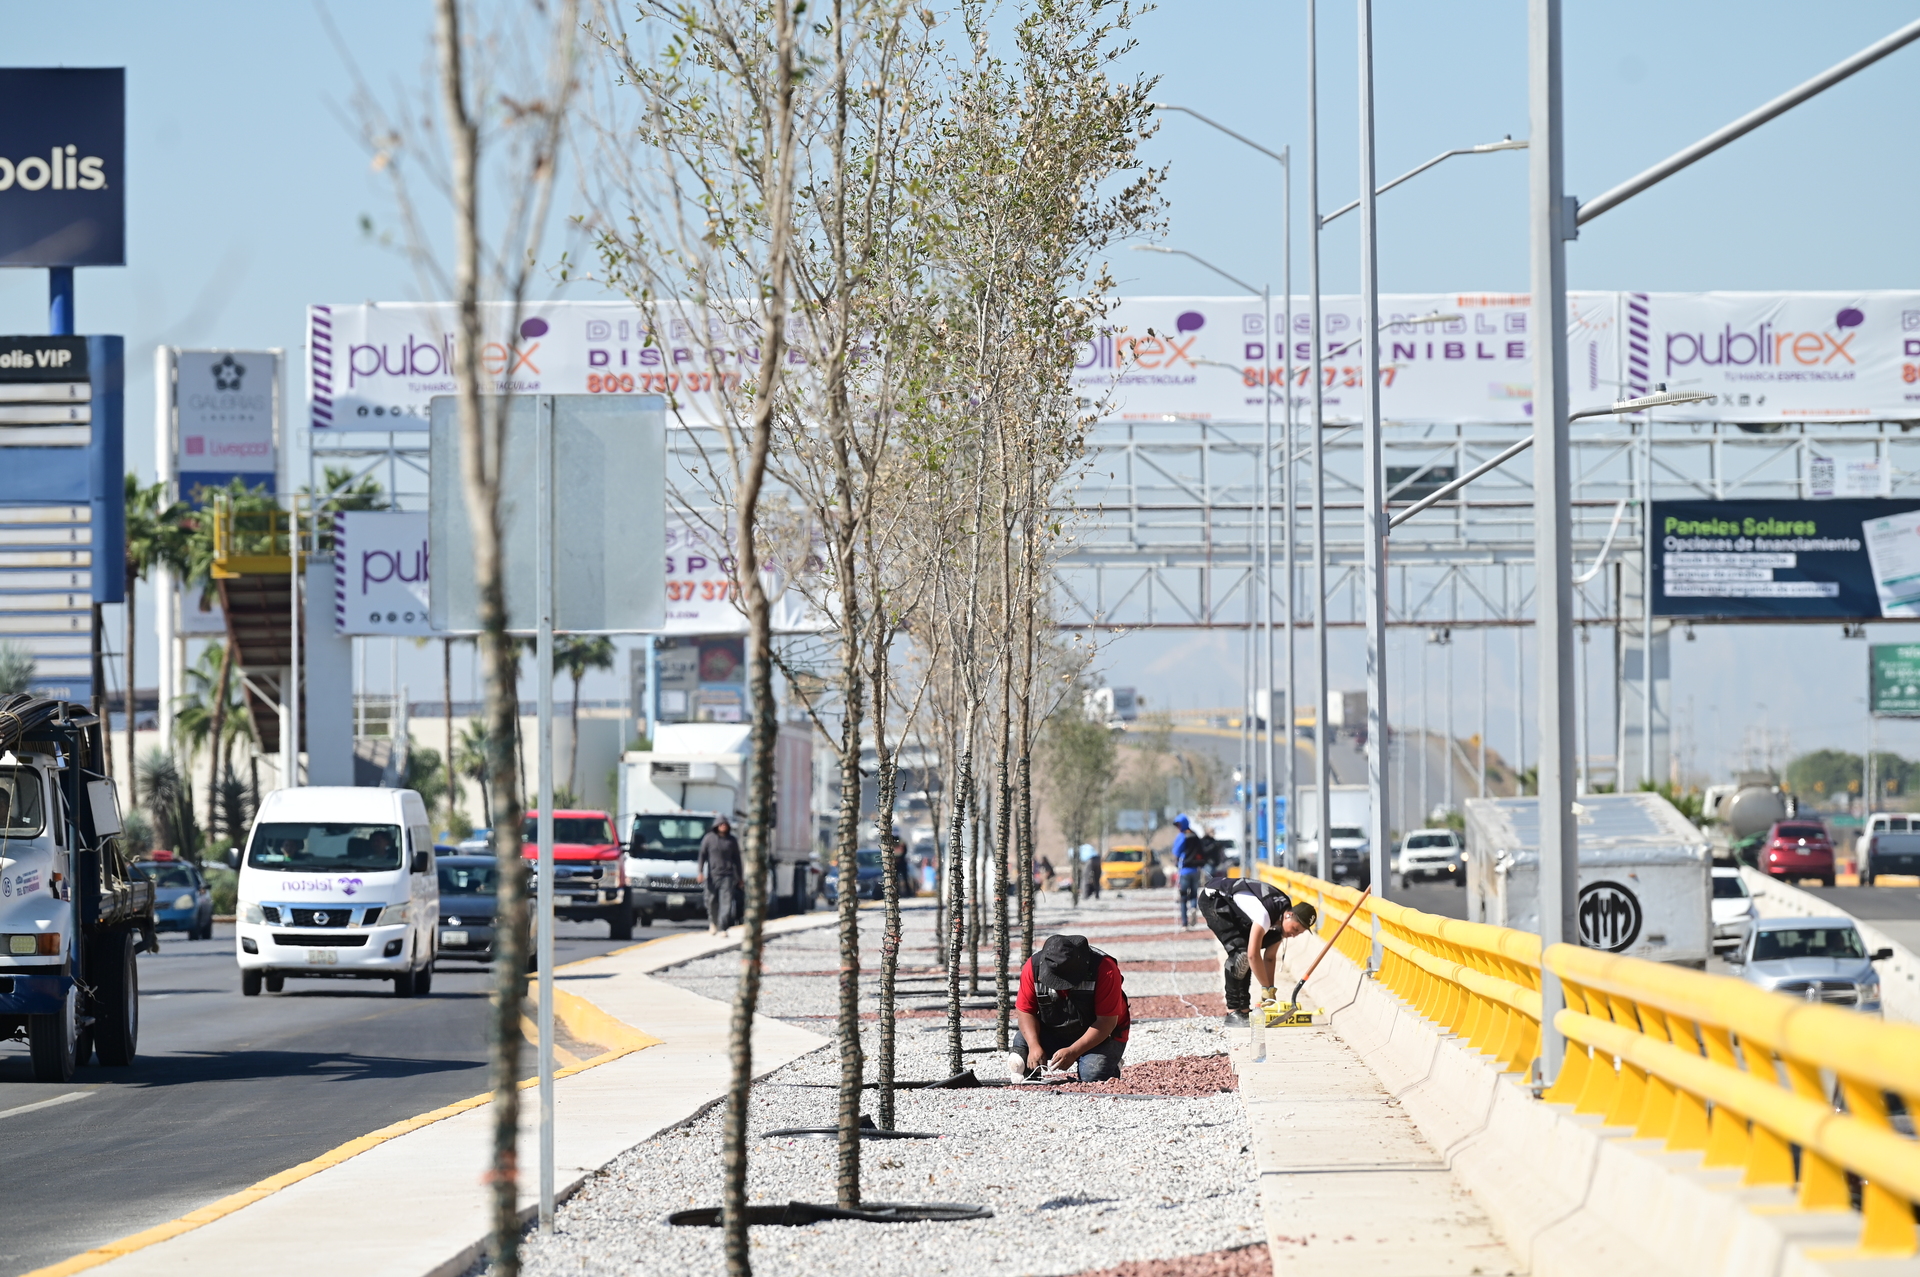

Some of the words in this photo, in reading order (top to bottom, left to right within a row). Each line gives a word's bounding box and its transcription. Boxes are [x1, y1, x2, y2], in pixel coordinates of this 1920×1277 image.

[1242, 313, 1526, 335] DISPNIBLE
[35, 349, 72, 368] VIP
[1245, 341, 1525, 360] DISPNIBLE
[1666, 322, 1856, 377] publirex
[349, 334, 540, 389] publiex
[586, 372, 634, 394] 800
[1294, 366, 1337, 387] 77
[1664, 516, 1741, 536] Paneles
[1742, 516, 1817, 536] Solares
[1663, 535, 1733, 553] Opciones
[1734, 535, 1754, 551] de
[1755, 535, 1861, 552] financiamiento
[1579, 891, 1632, 945] MYM
